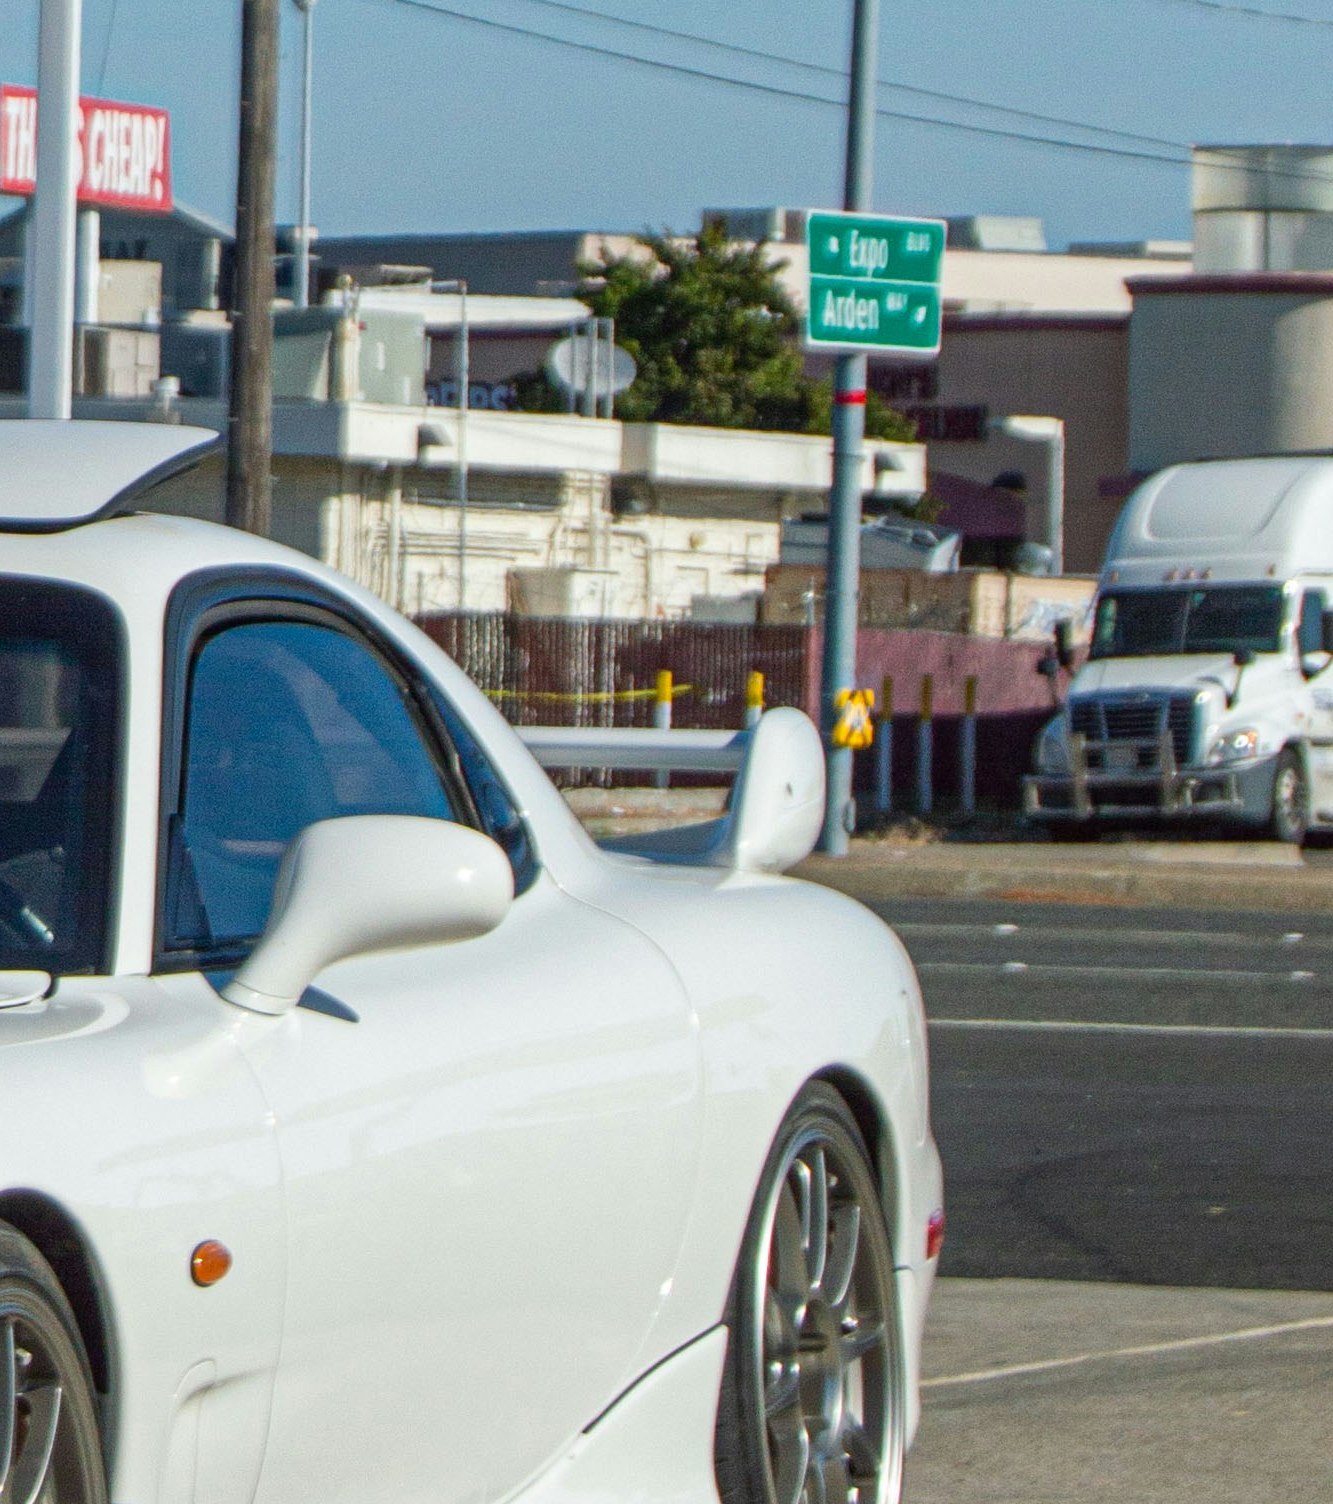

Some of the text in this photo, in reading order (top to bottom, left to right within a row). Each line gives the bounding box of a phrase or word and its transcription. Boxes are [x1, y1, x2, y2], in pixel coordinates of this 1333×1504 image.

[87, 108, 167, 202] CHEAP!
[848, 229, 889, 279] Expo
[822, 289, 880, 331] Arden
